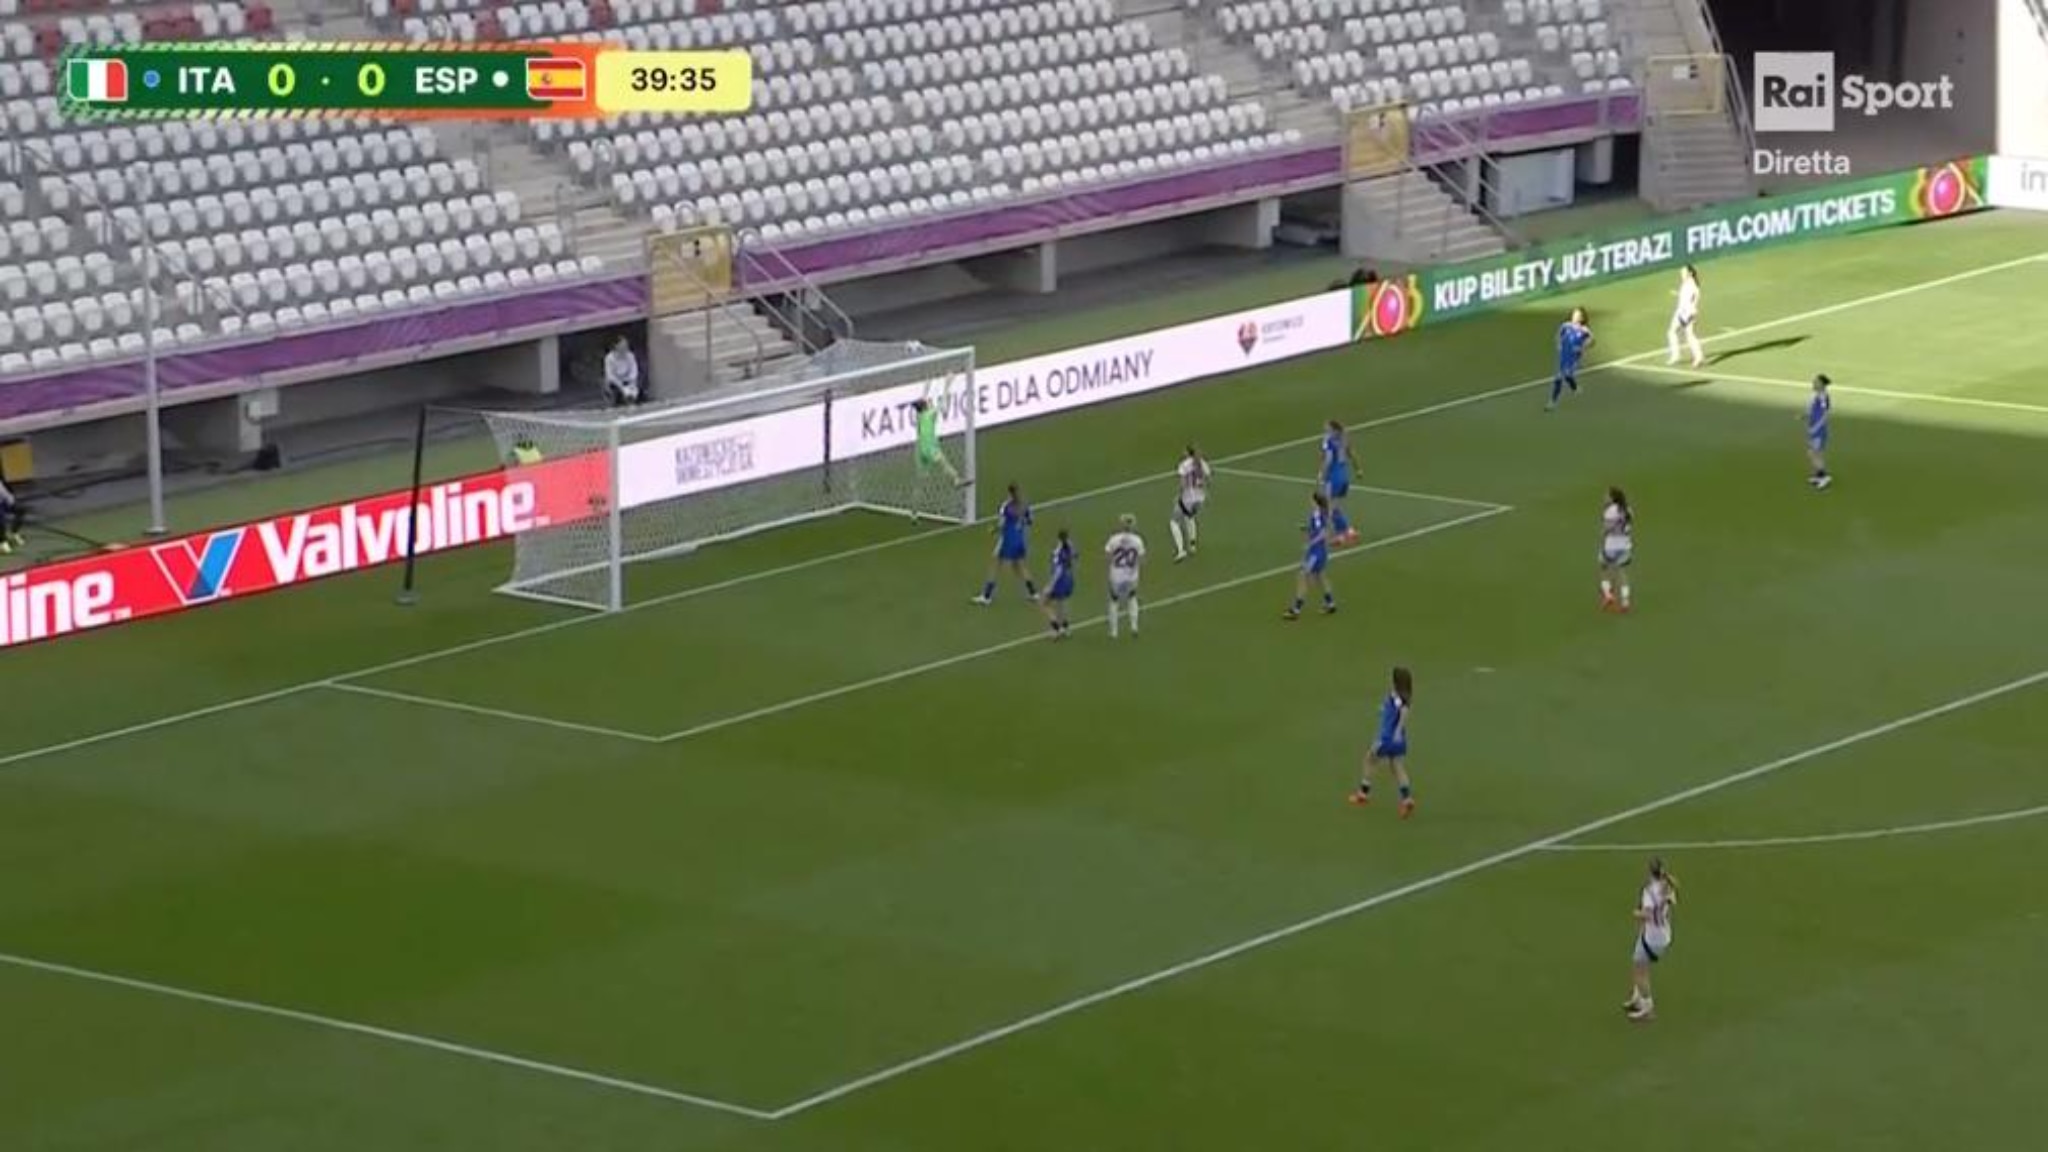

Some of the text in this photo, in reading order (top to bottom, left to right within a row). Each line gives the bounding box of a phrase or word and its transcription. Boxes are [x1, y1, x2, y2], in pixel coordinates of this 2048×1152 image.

[1434, 188, 1896, 311] KUP BILETY JUŻ TERAZ! FIFA.COM/TICKETS
[997, 374, 1040, 410] DLA
[1046, 349, 1153, 398] ODMIANY
[257, 481, 535, 585] Valvoline
[1113, 547, 1138, 568] 20
